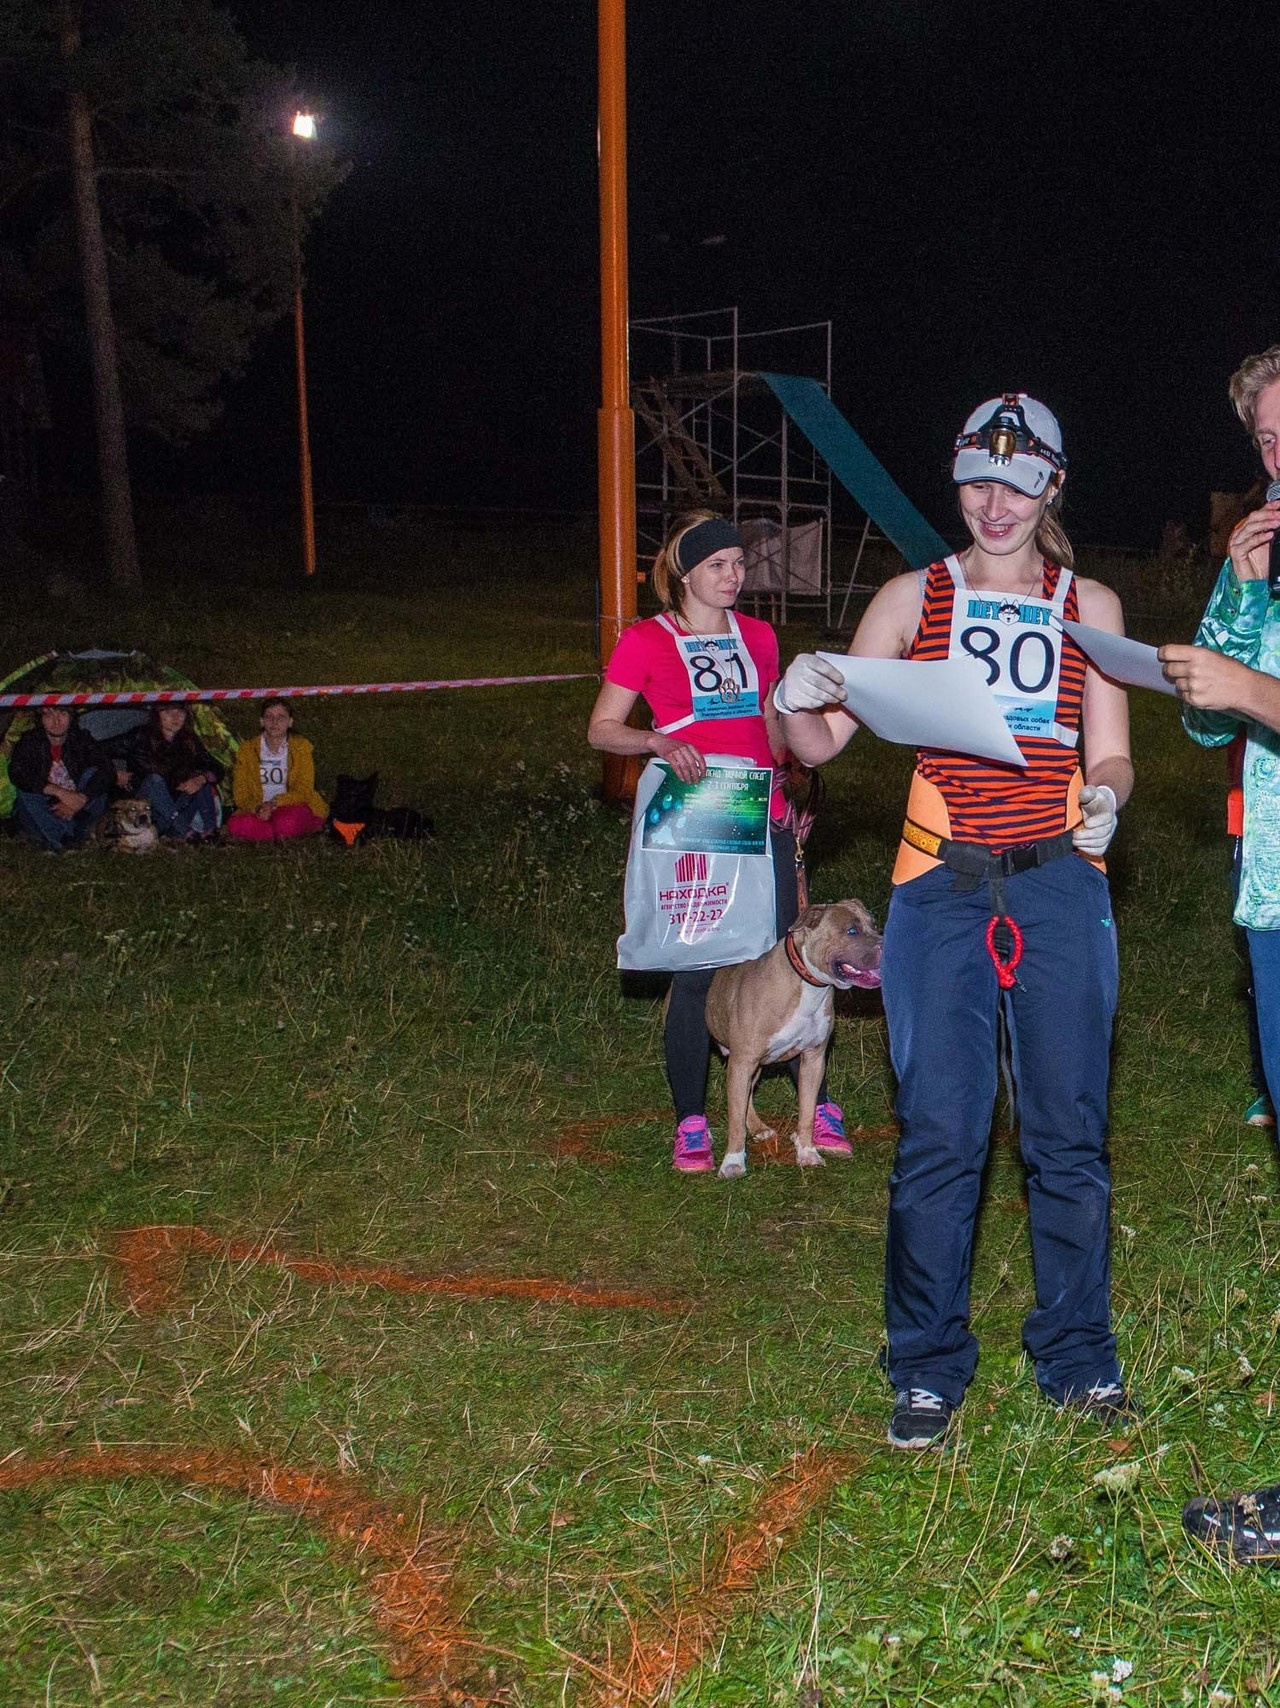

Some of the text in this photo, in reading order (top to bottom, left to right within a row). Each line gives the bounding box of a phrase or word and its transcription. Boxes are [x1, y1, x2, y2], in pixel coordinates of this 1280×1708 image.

[967, 600, 1052, 626] HEY HEY
[960, 626, 1055, 694] 80
[690, 653, 748, 692] 81
[1014, 723, 1041, 731] области
[660, 886, 727, 901] НАХОДКА
[669, 909, 723, 924] 310-22-22
